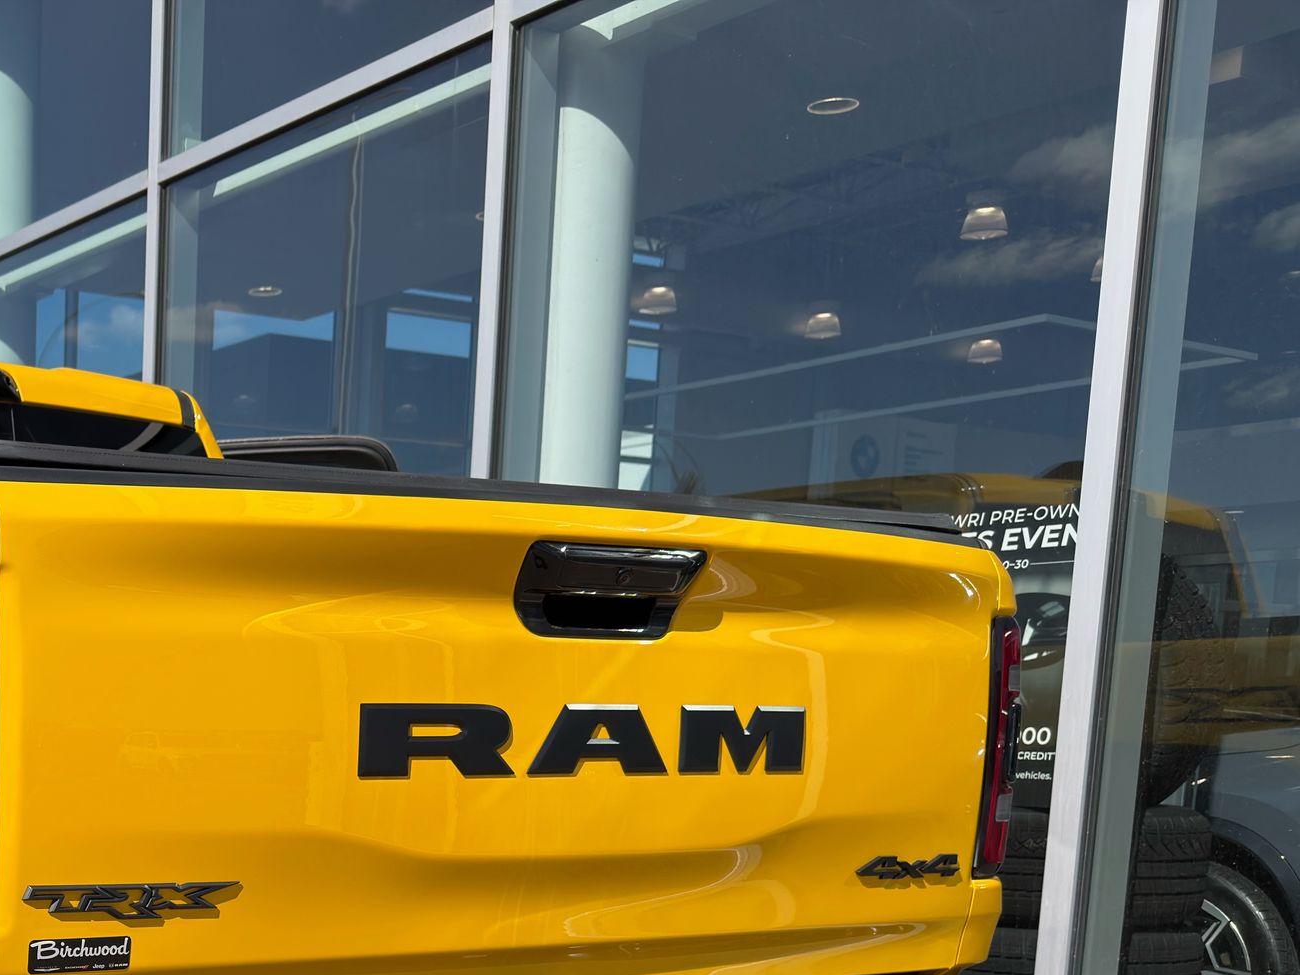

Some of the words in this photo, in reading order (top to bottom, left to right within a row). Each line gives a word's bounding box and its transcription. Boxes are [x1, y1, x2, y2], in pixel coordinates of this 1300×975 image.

[358, 703, 806, 779] RAM
[855, 853, 961, 880] 4x4
[21, 880, 241, 919] TRX
[30, 937, 130, 960] Birchwood
